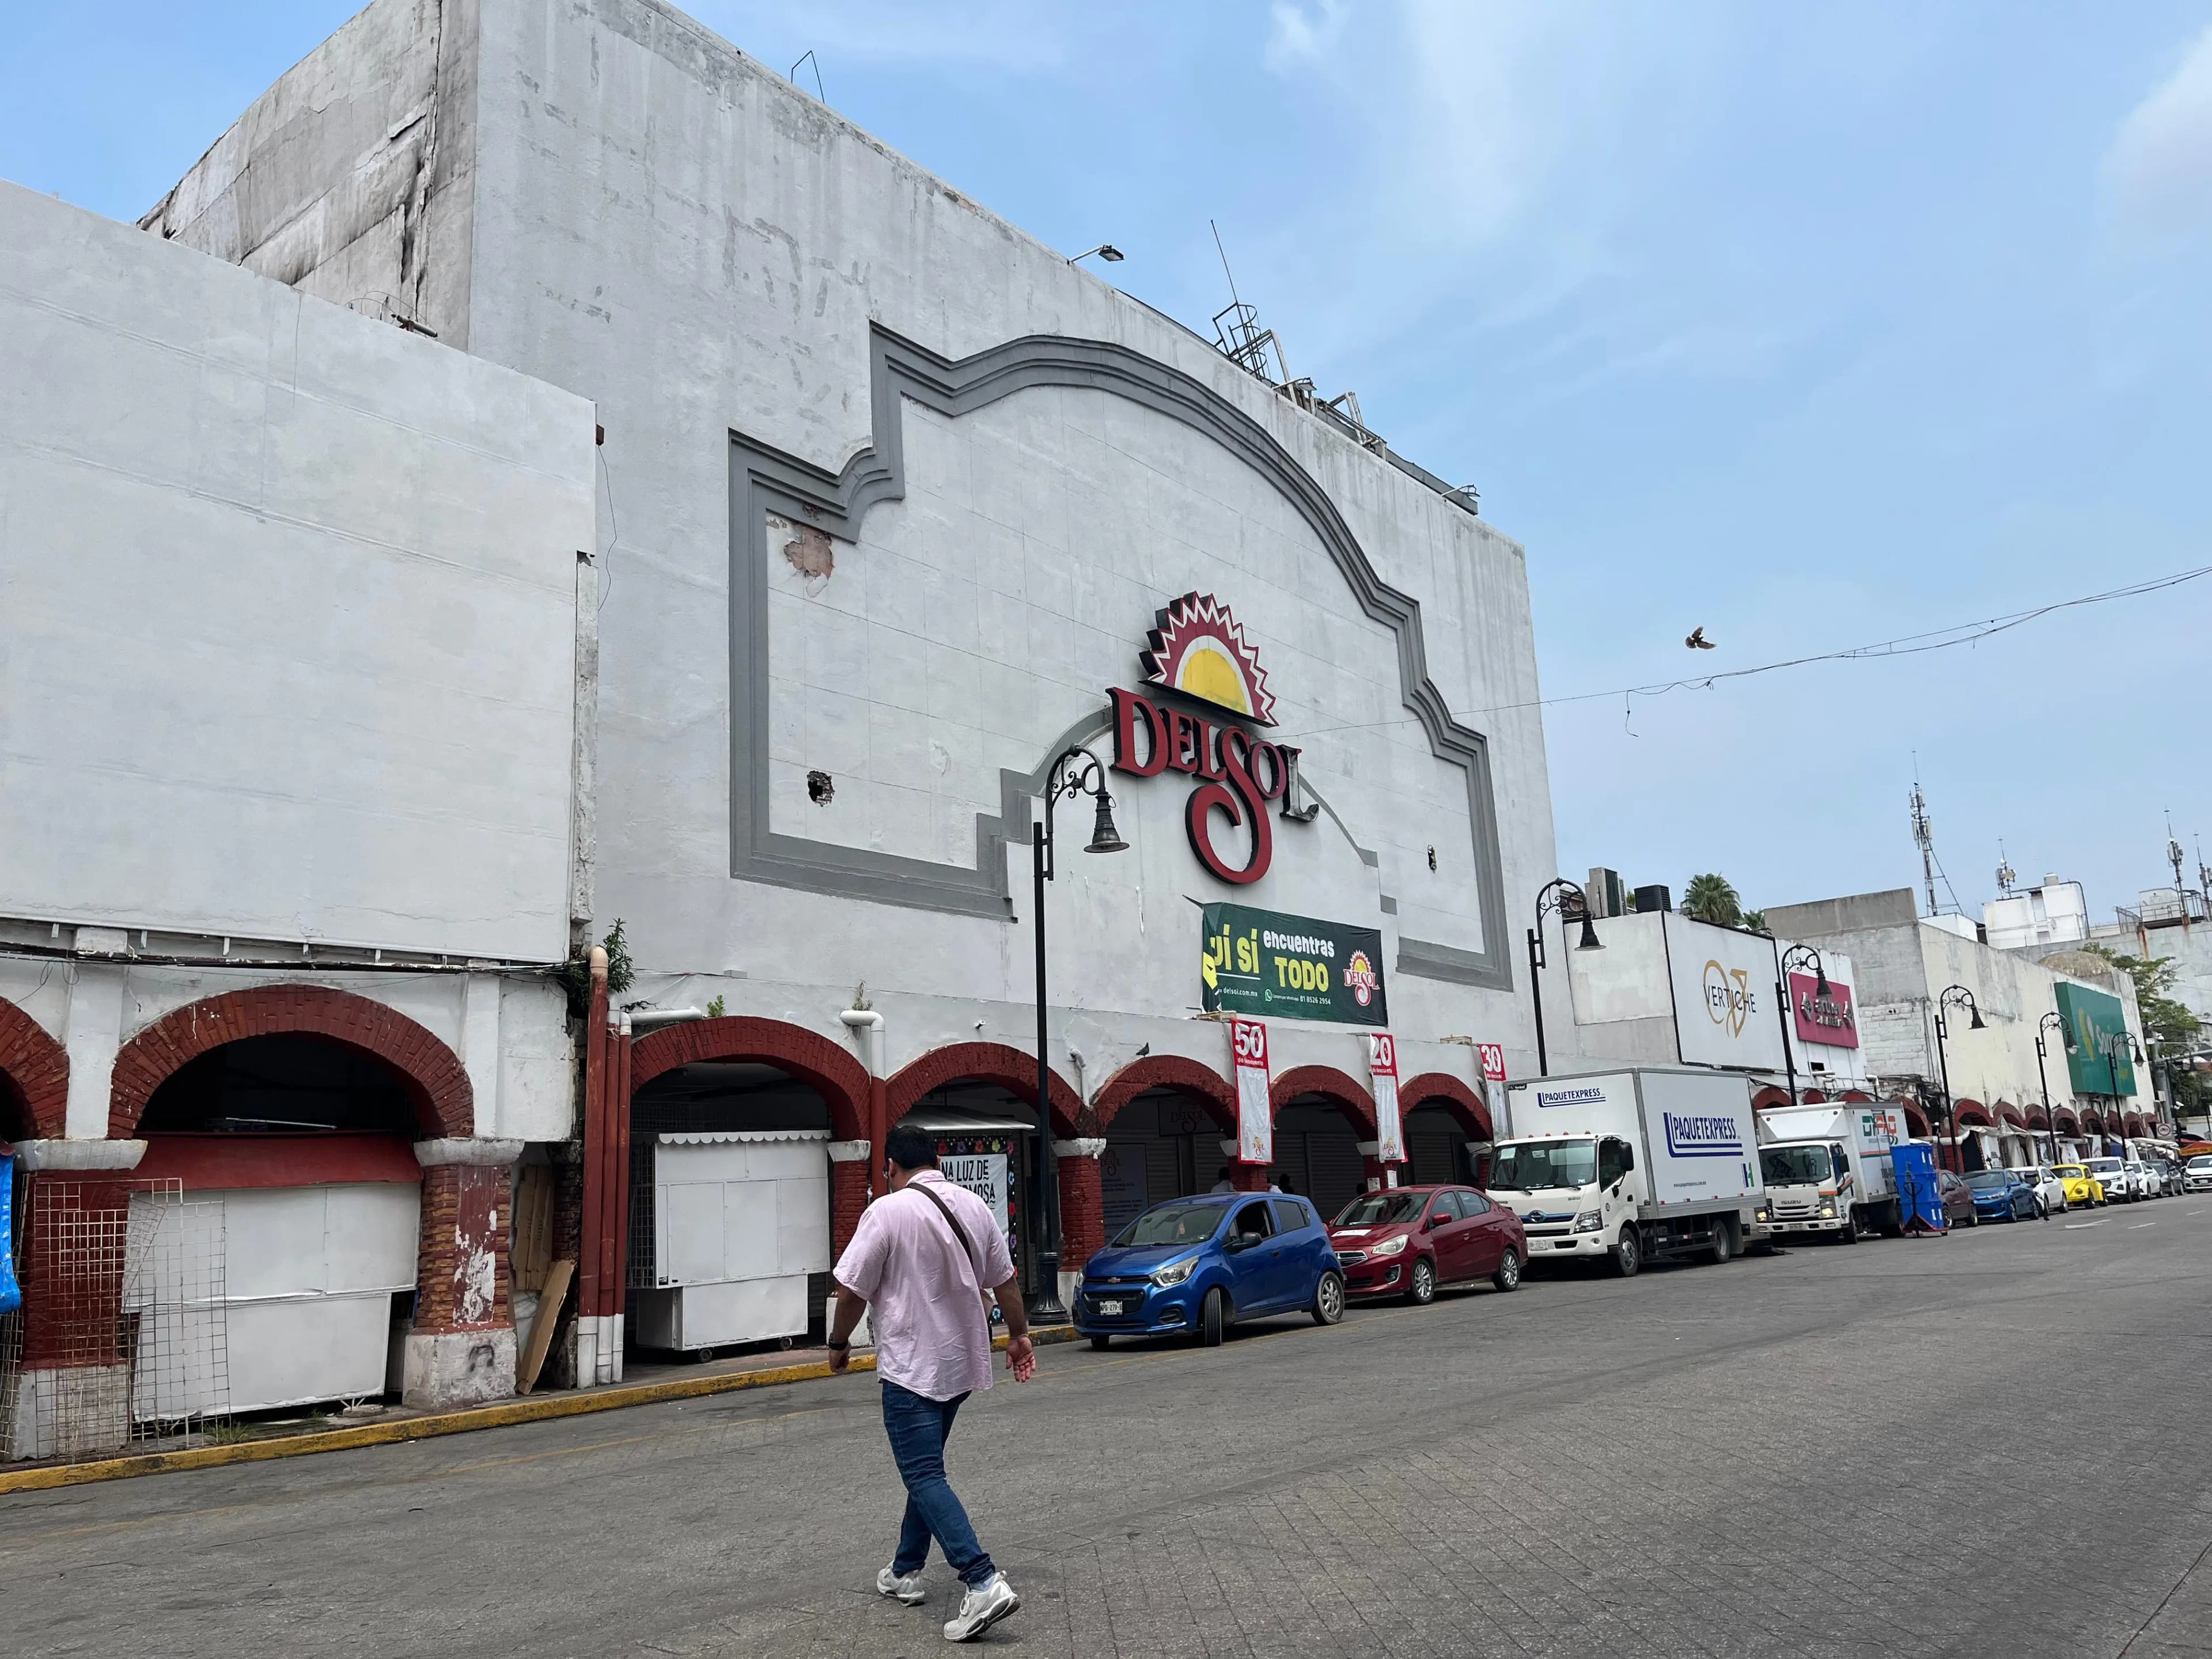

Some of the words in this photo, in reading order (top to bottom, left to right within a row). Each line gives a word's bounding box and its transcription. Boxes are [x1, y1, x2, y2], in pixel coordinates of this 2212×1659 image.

[1263, 930, 1335, 958] encuentras
[1274, 956, 1329, 992] TODO
[1223, 987, 1258, 997] delsol.com.mx
[1703, 984, 1756, 1013] VERTICHE
[1235, 1022, 1264, 1058] 50
[1370, 1036, 1392, 1066] 20
[1481, 1045, 1501, 1073] 30
[1545, 1088, 1601, 1101] PAQUETEXPRESS
[1673, 1116, 1736, 1141] PAQUETEXPRESS
[956, 1160, 974, 1181] LUZ
[977, 1159, 989, 1180] DE
